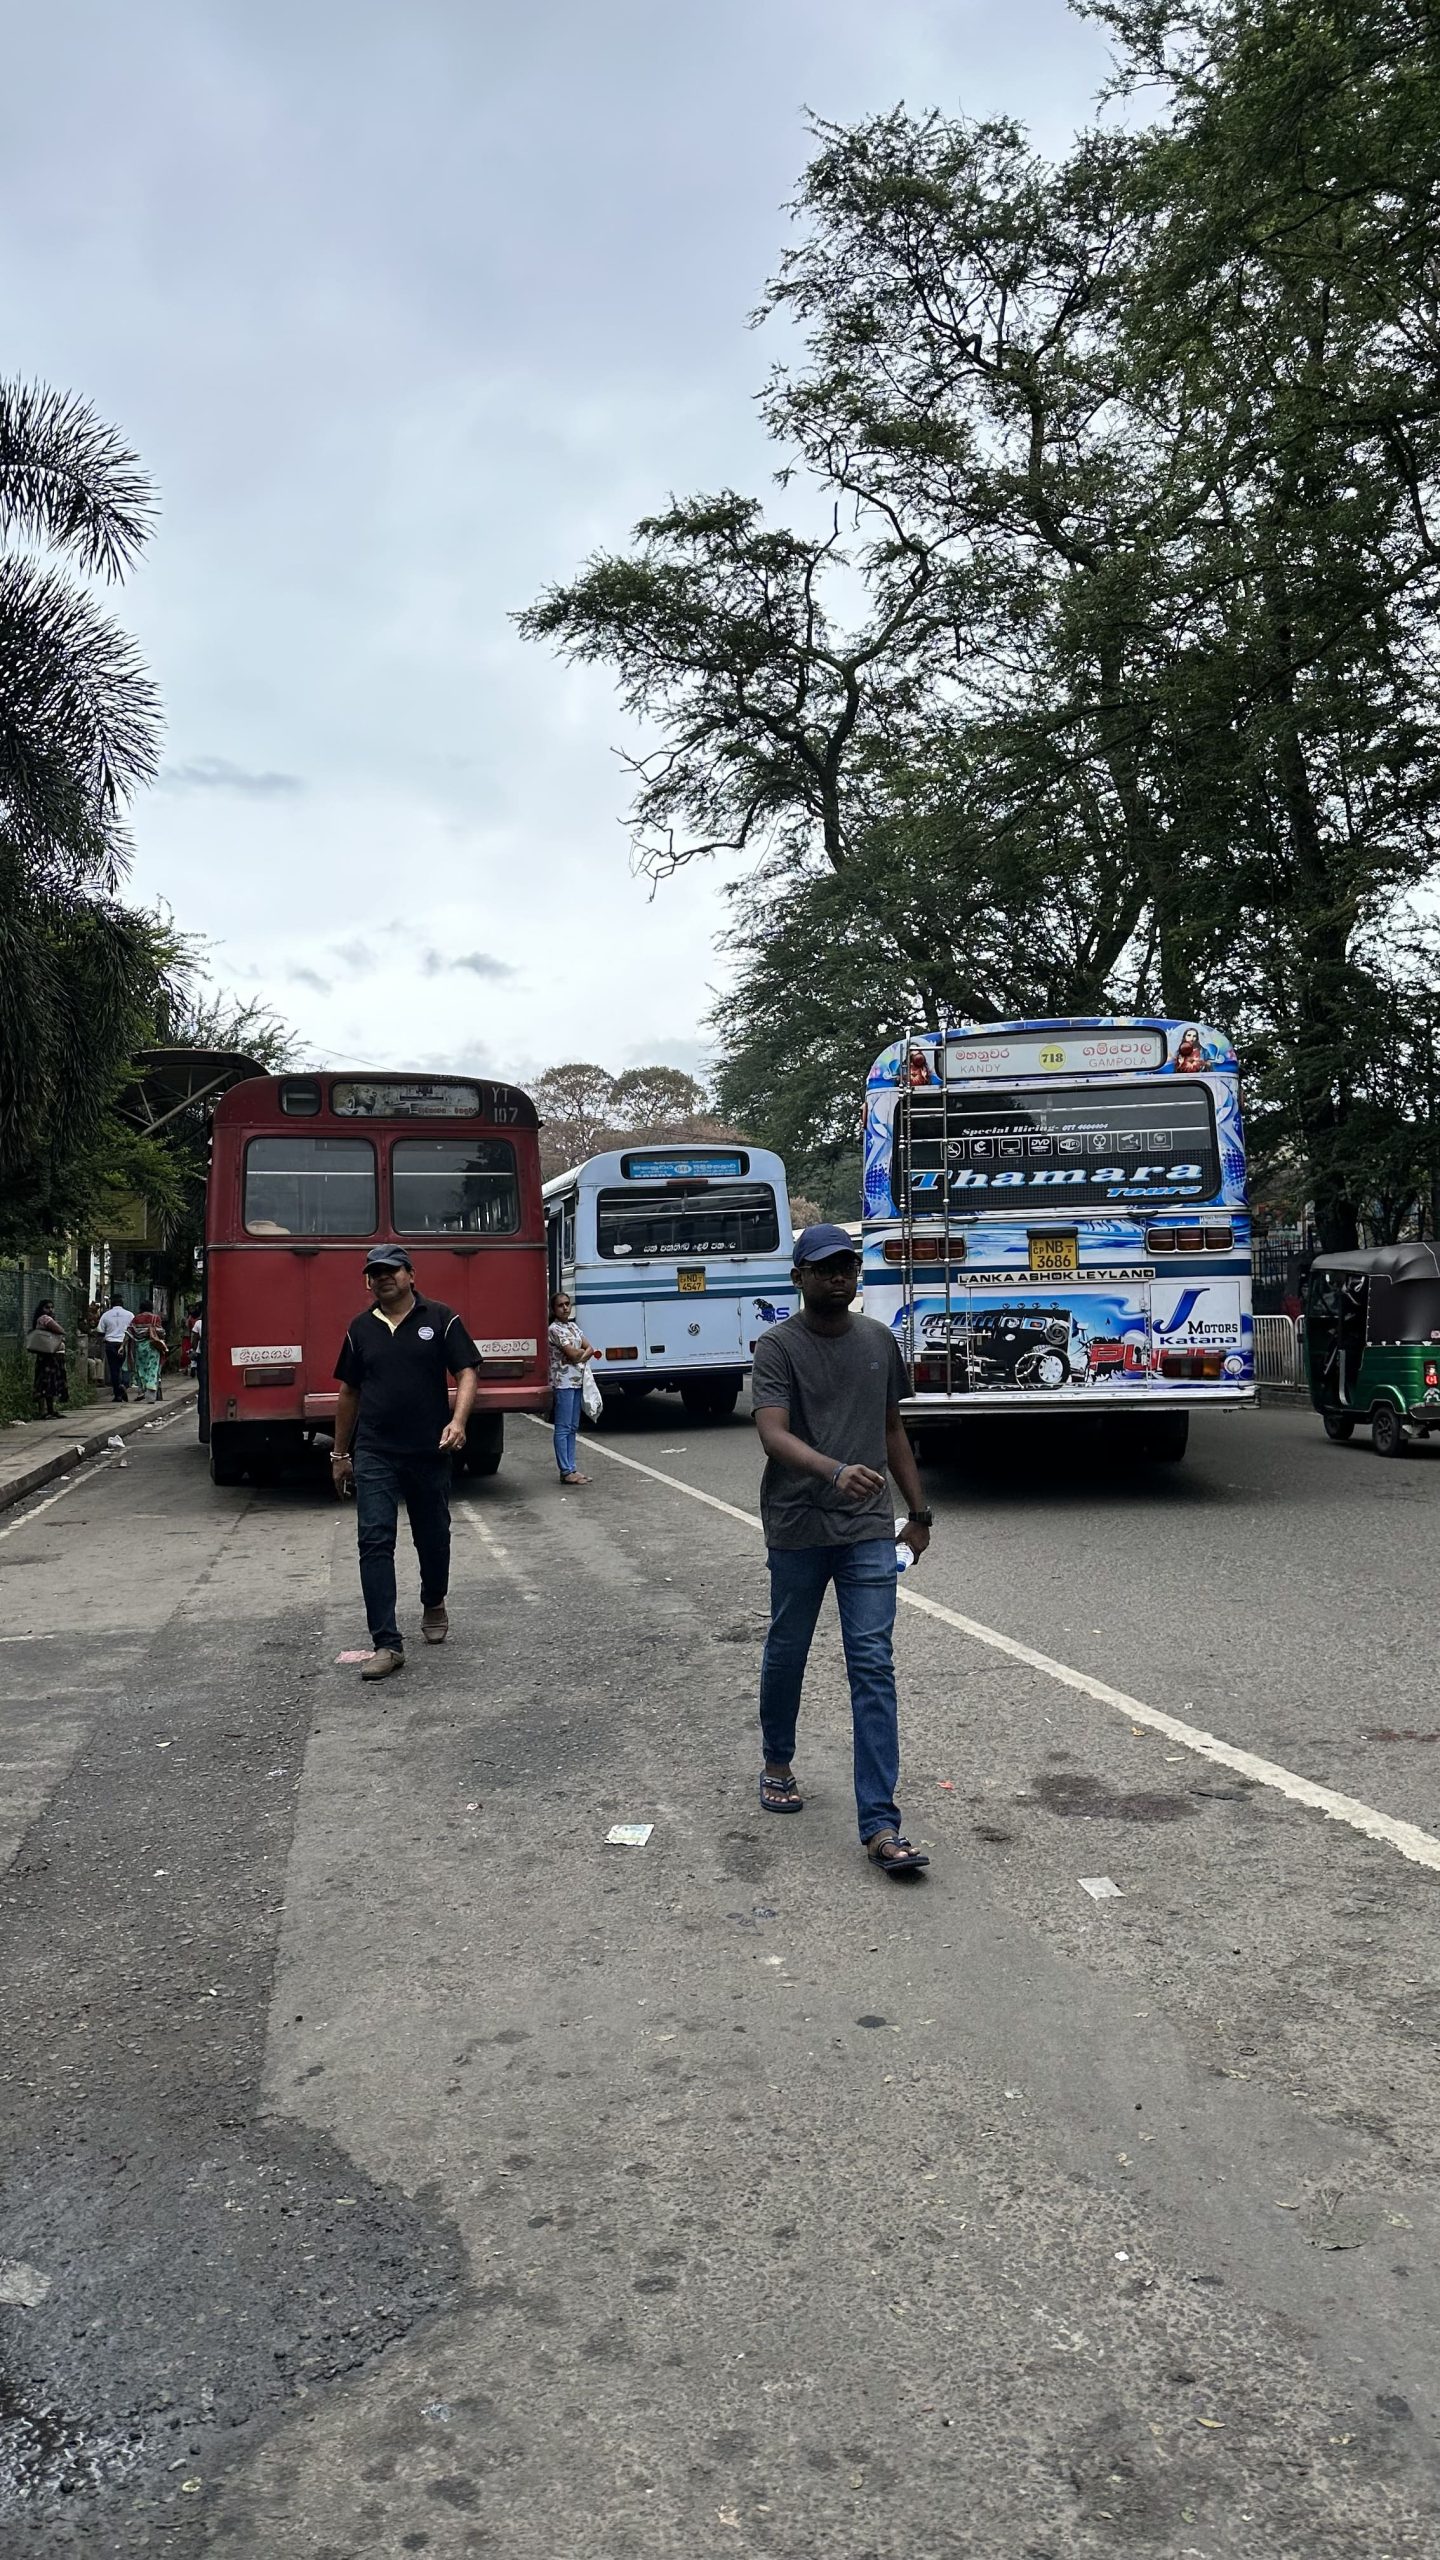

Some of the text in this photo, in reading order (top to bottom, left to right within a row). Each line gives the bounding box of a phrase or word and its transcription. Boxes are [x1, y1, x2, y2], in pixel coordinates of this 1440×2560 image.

[955, 1048, 1010, 1063] මහනුවර
[1082, 1042, 1152, 1056] ගම්පොල
[1041, 1053, 1064, 1063] 718
[1088, 1057, 1147, 1068] GAMPOLA
[960, 1064, 1001, 1074] KANDY
[491, 1087, 509, 1103] YT
[493, 1107, 519, 1123] 107
[961, 1126, 1010, 1137] Special
[1031, 1138, 1050, 1147] DVD
[911, 1163, 1203, 1191] Thamara
[1045, 1240, 1064, 1254] NB
[1037, 1254, 1072, 1269] 3686
[959, 1269, 1155, 1284] LANKA ASHOK LEYLAND
[1159, 1336, 1237, 1345] Katana
